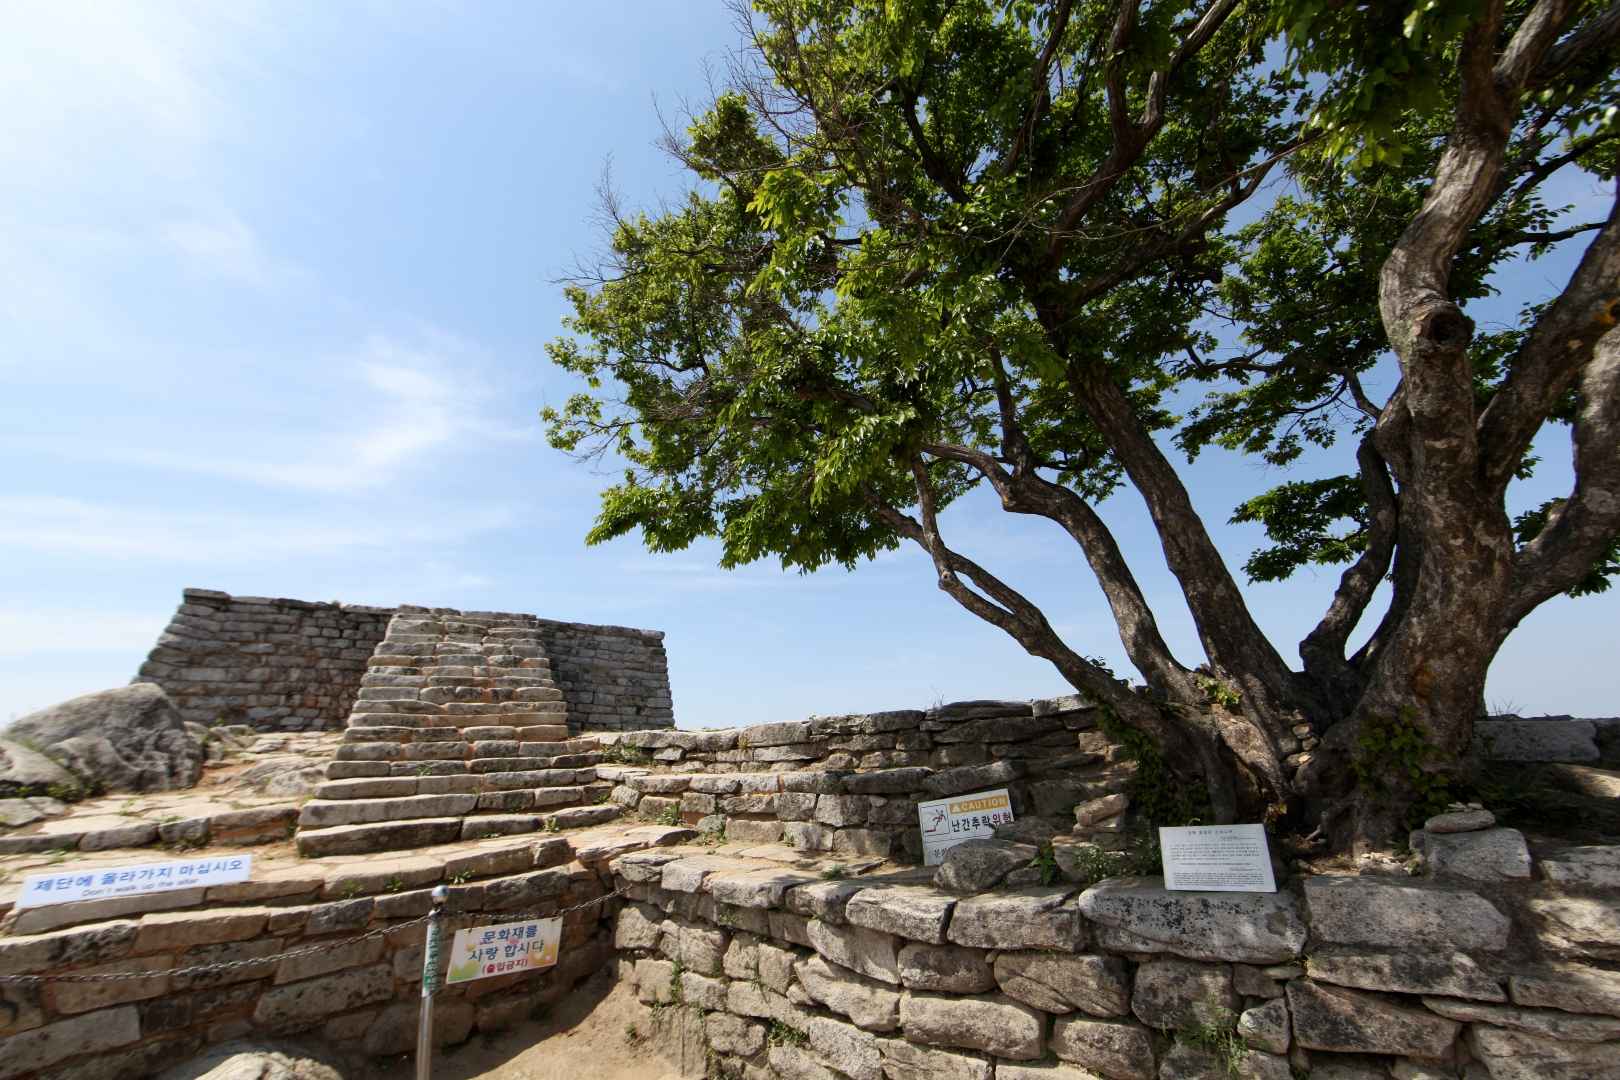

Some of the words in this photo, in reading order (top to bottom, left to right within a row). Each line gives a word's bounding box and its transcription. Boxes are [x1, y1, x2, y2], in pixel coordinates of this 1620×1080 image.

[962, 797, 1006, 810] CAUTION
[34, 875, 93, 891] 제단에
[102, 867, 172, 885] 올라가지
[179, 860, 243, 876] 마십시오
[481, 925, 537, 944] 문화재를
[469, 947, 498, 961] 사랑
[504, 940, 544, 957] 합시다
